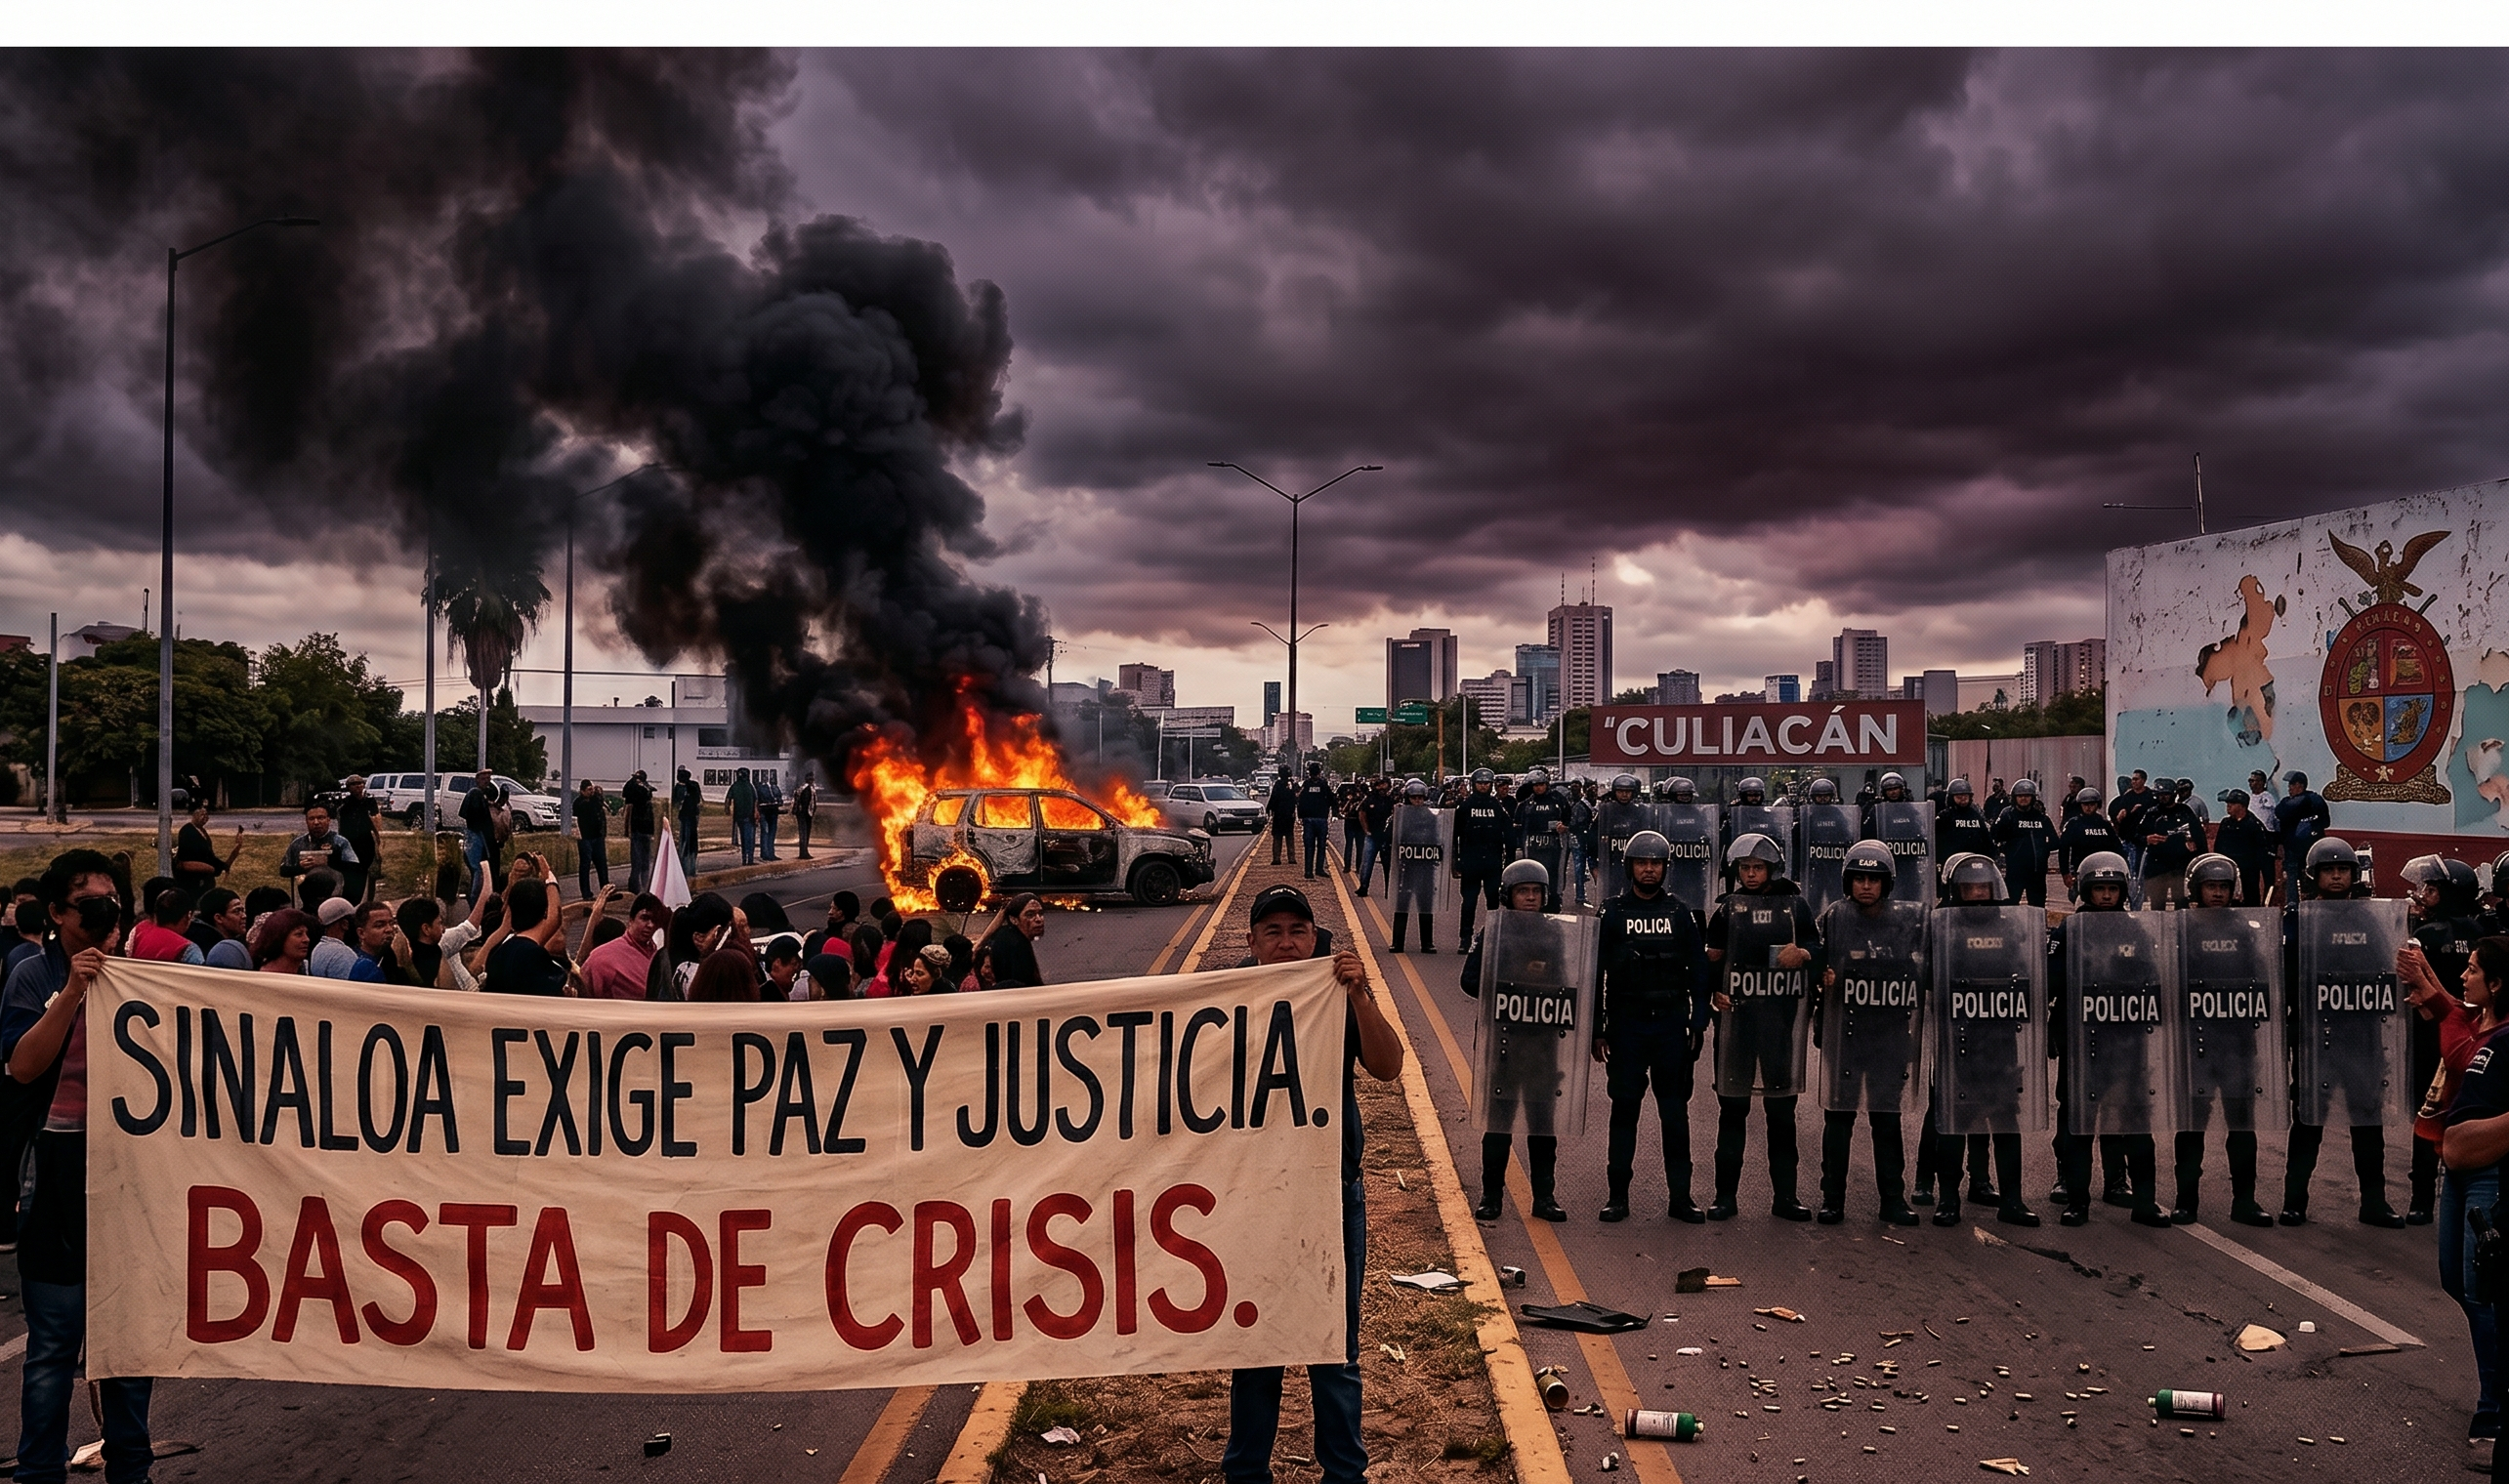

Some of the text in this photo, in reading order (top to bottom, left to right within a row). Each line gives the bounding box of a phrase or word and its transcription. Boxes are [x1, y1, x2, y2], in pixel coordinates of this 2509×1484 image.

[1626, 918, 1673, 934] POLICA
[1730, 970, 1803, 997] POLICIA
[1495, 993, 1573, 1026] POLICIA
[110, 1000, 1329, 1158] SINALOA EXIGE PAZ Y JUSTICIA.
[187, 1182, 1259, 1353] BASTA DE CRISIS.
